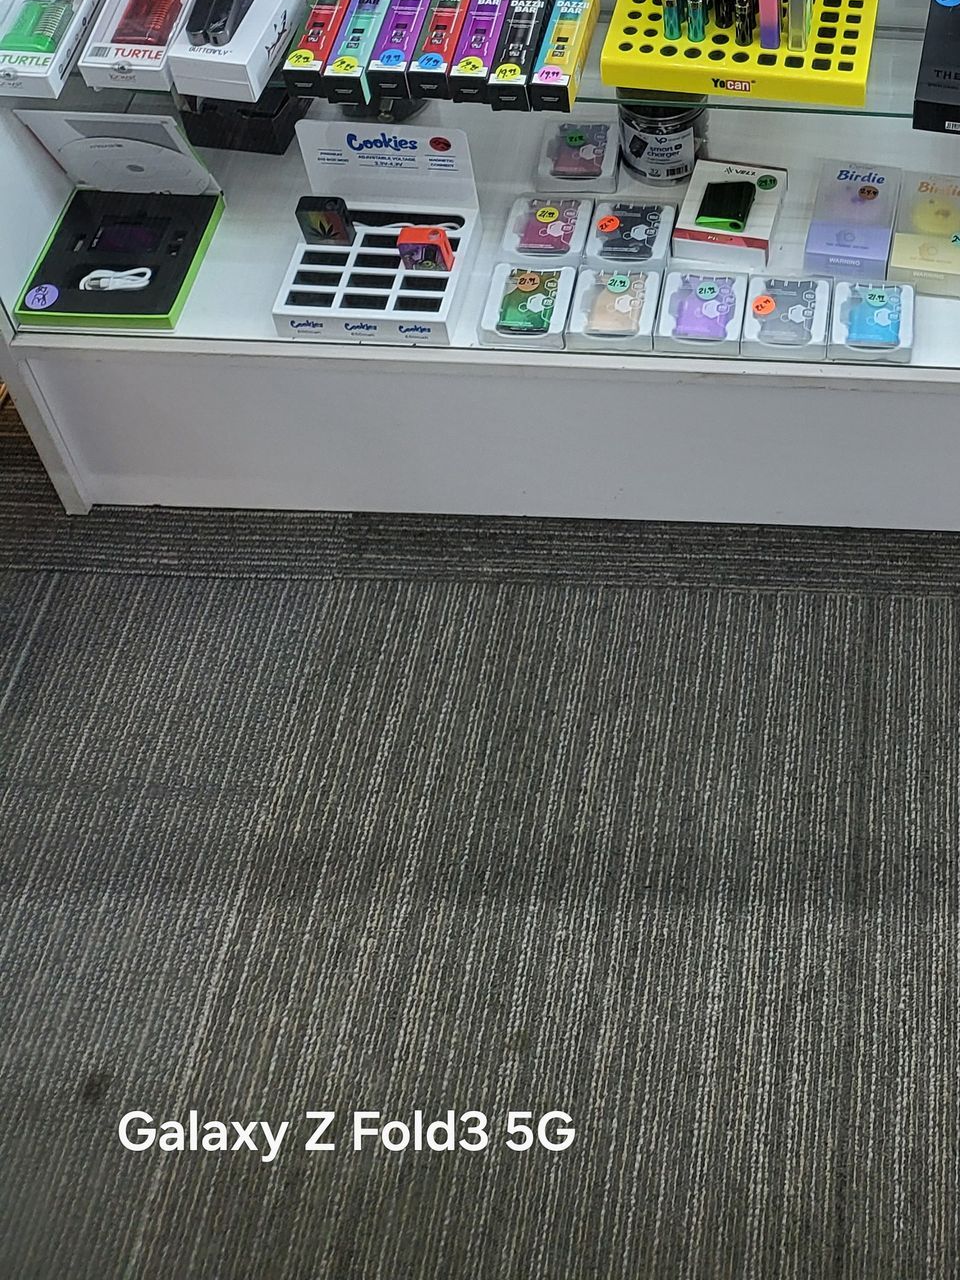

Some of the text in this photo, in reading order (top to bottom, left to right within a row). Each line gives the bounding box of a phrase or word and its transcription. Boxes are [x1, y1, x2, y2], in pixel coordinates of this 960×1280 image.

[114, 48, 164, 60] TURTLE
[712, 78, 751, 92] Yocan
[346, 132, 418, 152] Cookies
[646, 150, 681, 158] charger
[837, 168, 886, 186] Birdie
